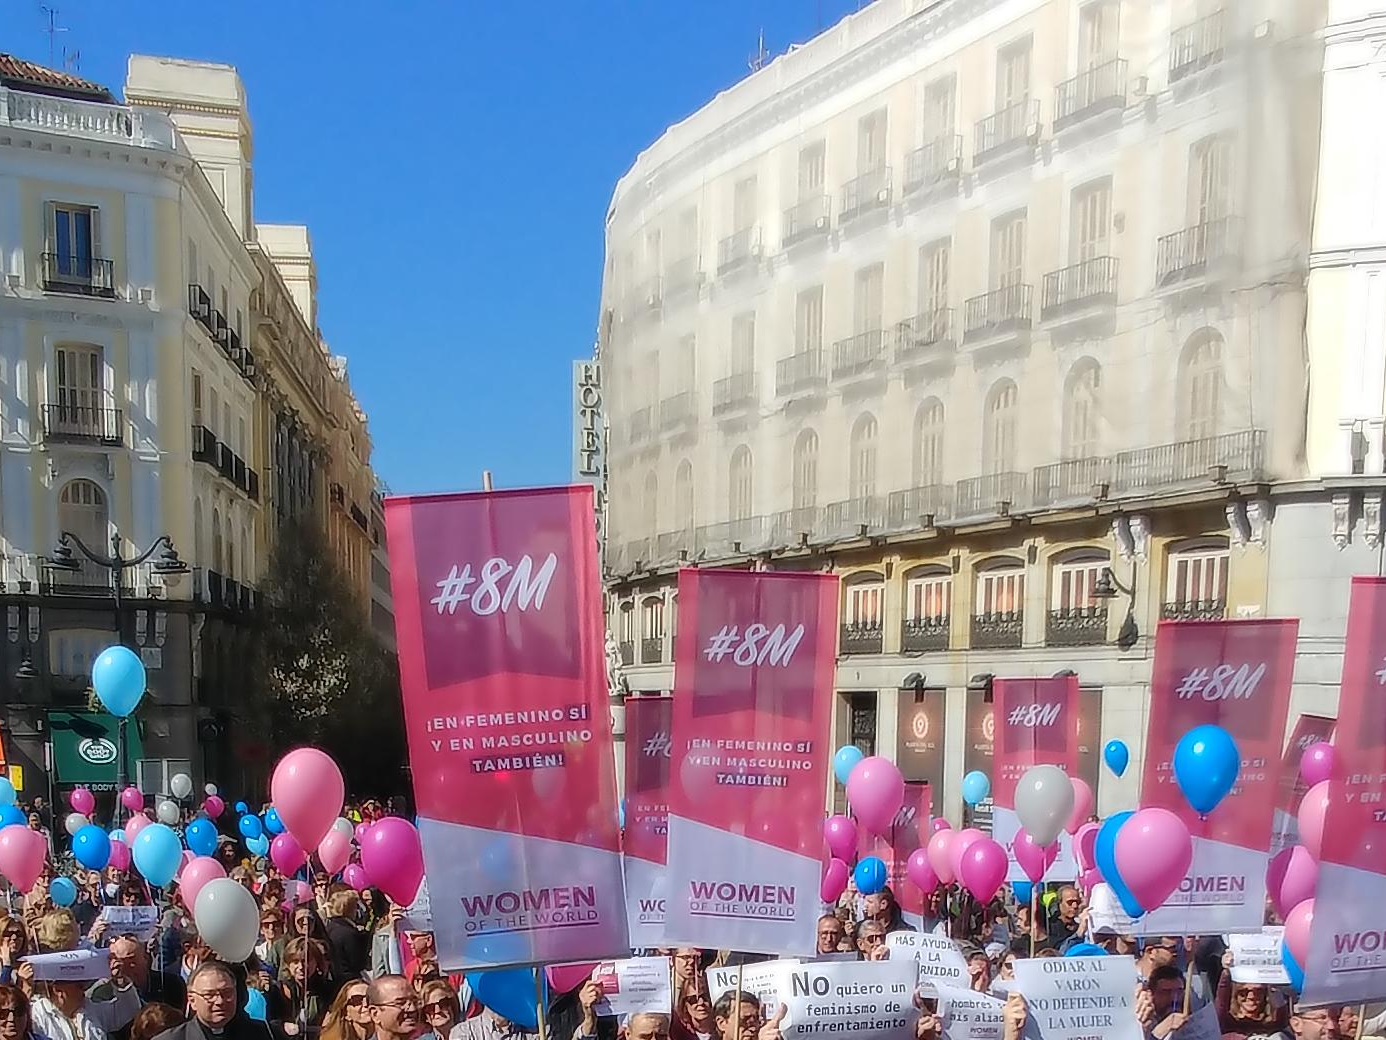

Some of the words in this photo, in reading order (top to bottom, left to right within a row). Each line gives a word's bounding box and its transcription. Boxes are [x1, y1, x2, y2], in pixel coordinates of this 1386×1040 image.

[431, 552, 558, 615] #8M
[703, 623, 804, 667] #8M
[1176, 662, 1266, 701] #8M
[465, 709, 563, 728] FEMENINO
[569, 704, 587, 719] SÍ
[1008, 703, 1062, 726] #8M
[430, 740, 442, 752] Y
[450, 738, 474, 750] EN
[482, 729, 592, 749] MASCULINO
[716, 739, 792, 752] FEMENINO
[797, 741, 811, 753] SÍ
[473, 753, 563, 772] TAMBIÉN!
[687, 756, 695, 765] Y
[702, 756, 720, 766] EN
[726, 757, 812, 770] MASCULINO
[716, 773, 787, 787] TAMBIÉN!
[1345, 792, 1354, 802] Y
[1360, 792, 1381, 802] EN
[1179, 876, 1245, 892] OMEN
[691, 881, 795, 904] WOMEN
[461, 886, 596, 917] WOMEN
[690, 901, 714, 911] OF
[721, 903, 743, 914] THE
[748, 904, 795, 918] WORLD
[465, 920, 488, 932] OF
[495, 915, 525, 928] THE
[535, 910, 597, 924] WORLD
[914, 951, 922, 961] A
[928, 952, 941, 962] LA
[920, 965, 960, 977] RNIDAD
[1043, 961, 1086, 974] ODIAR
[1090, 960, 1106, 971] AL
[792, 972, 830, 997] No
[836, 984, 883, 998] quiero
[892, 983, 906, 993] un
[1055, 976, 1101, 991] VARÓN
[806, 1004, 876, 1017] feminismo
[885, 1001, 900, 1014] de
[1030, 999, 1049, 1010] NO
[1053, 996, 1114, 1010] DEFIENDE
[1119, 996, 1127, 1007] A
[797, 1018, 906, 1034] enfrentamiento
[1049, 1018, 1065, 1029] LA
[1070, 1015, 1113, 1028] MUJER
